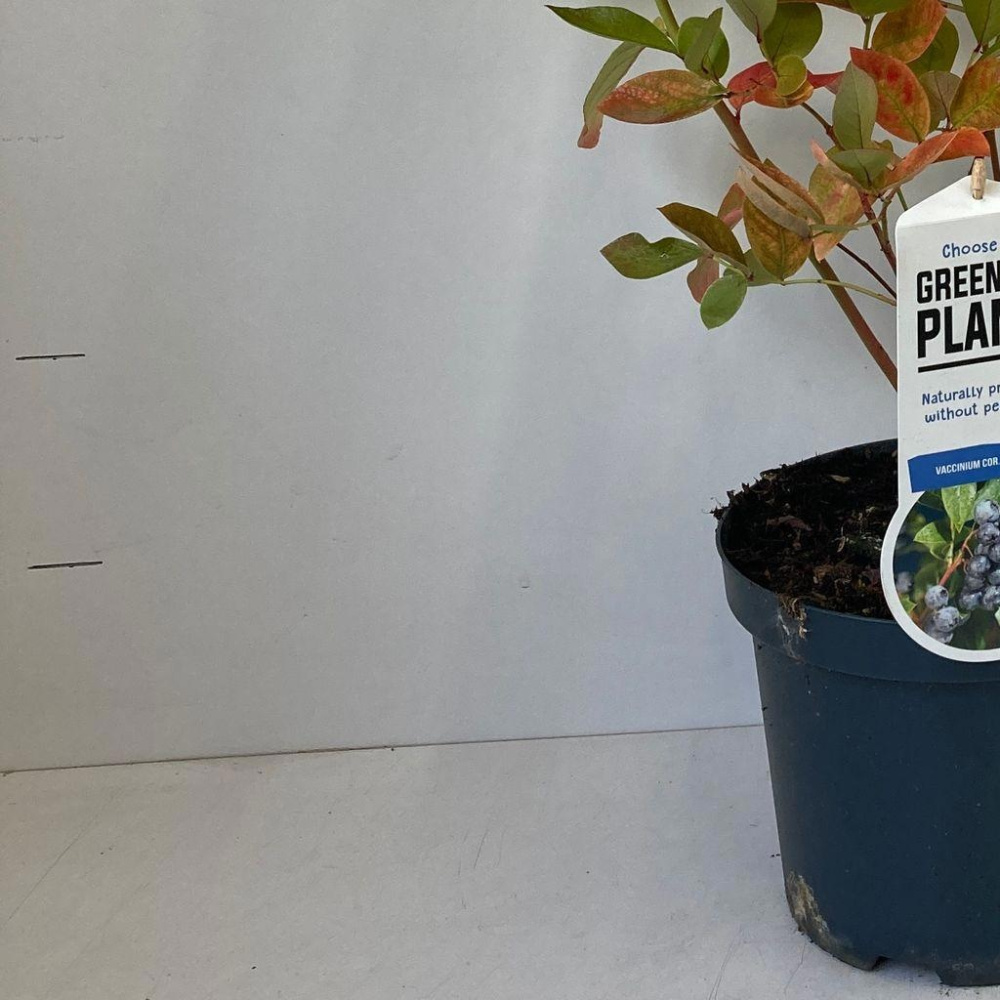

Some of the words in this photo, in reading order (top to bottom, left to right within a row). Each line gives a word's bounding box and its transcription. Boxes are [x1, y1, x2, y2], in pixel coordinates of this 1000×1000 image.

[942, 239, 998, 258] Choose
[922, 385, 984, 406] Naturally
[924, 403, 978, 423] without
[935, 459, 981, 476] VACCINIUM
[982, 456, 1000, 468] COR.
